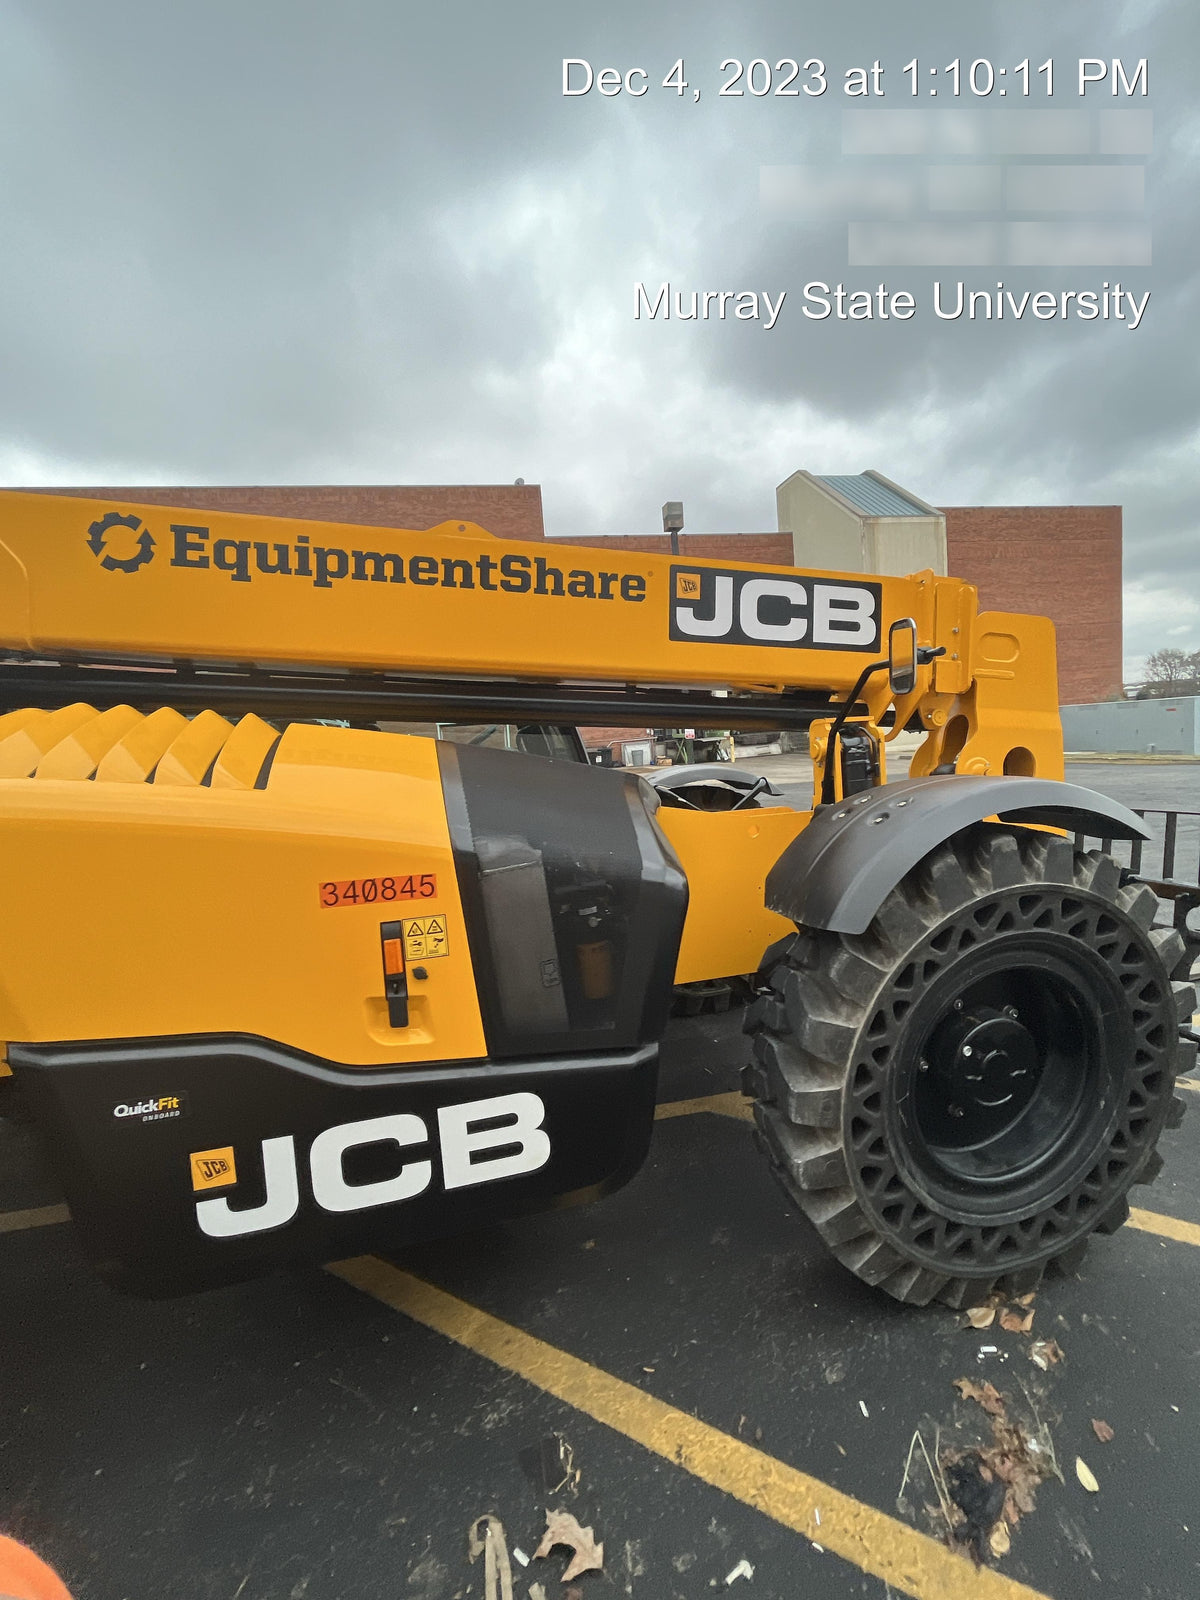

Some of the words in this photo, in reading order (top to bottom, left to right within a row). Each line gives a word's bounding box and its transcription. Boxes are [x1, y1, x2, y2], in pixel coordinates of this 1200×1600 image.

[169, 523, 647, 602] EquipmentShare
[675, 575, 877, 646] JCB
[322, 873, 436, 907] 340845
[113, 1096, 180, 1117] QuickFit
[142, 1110, 181, 1122] ONBOARD
[194, 1092, 551, 1238] JCB
[202, 1160, 228, 1178] JCB
